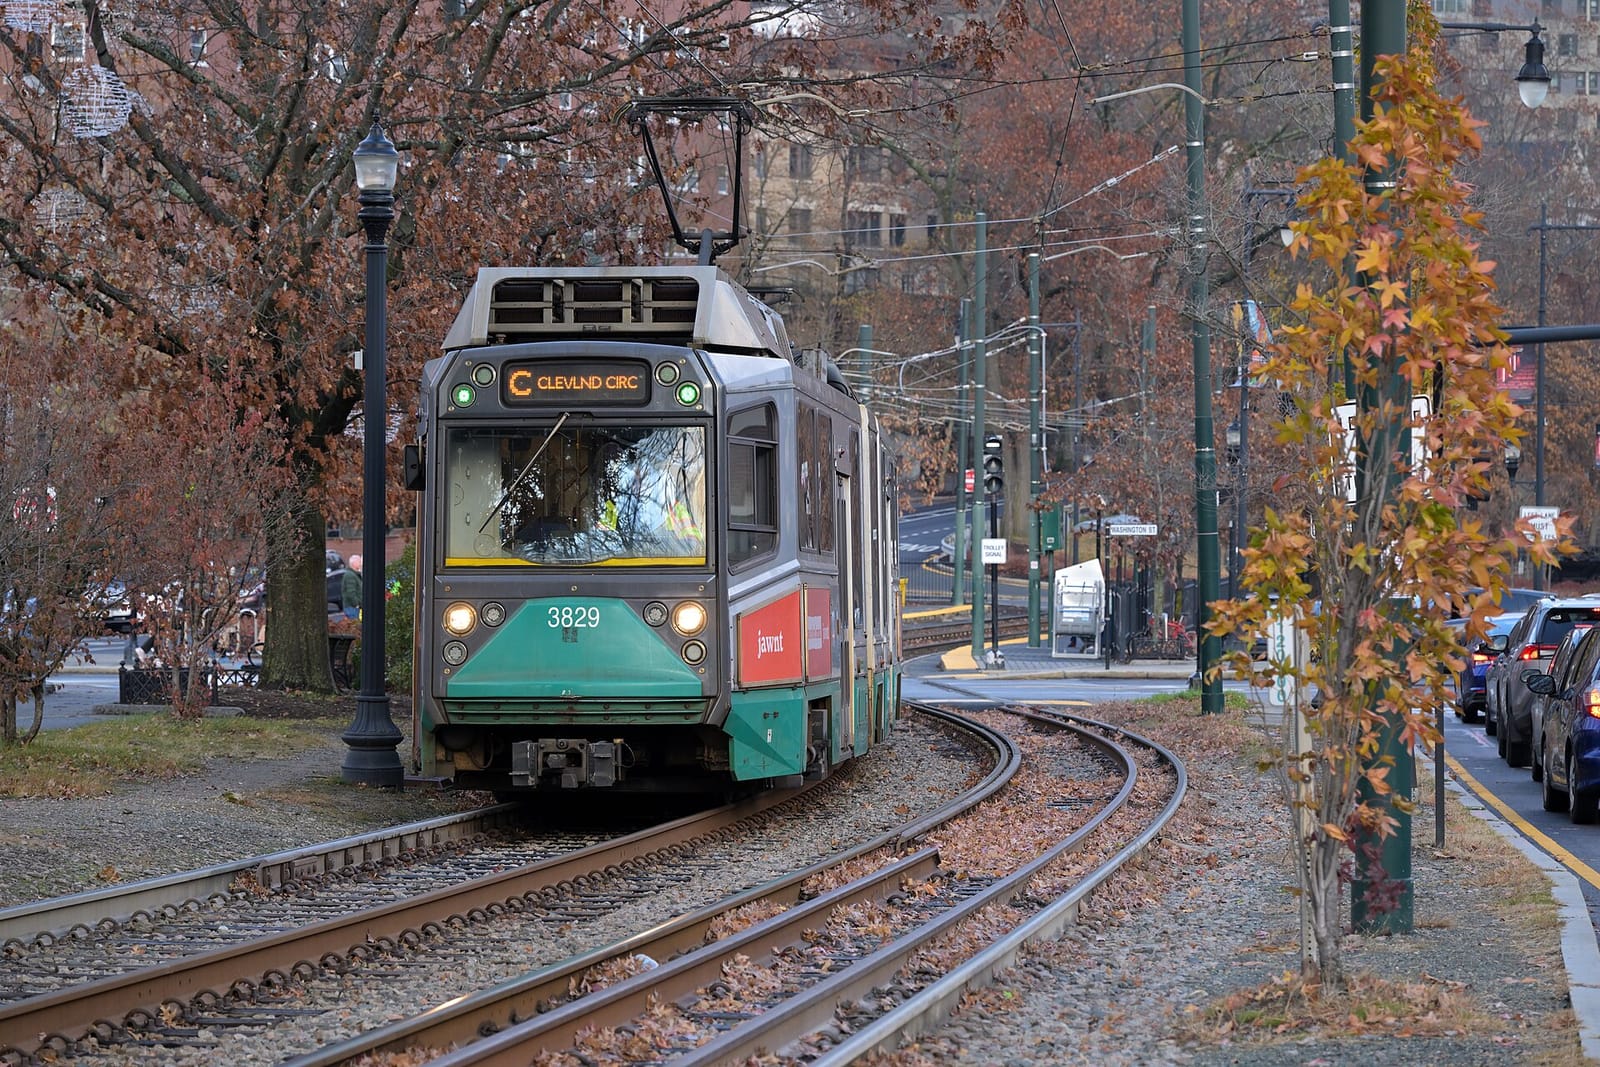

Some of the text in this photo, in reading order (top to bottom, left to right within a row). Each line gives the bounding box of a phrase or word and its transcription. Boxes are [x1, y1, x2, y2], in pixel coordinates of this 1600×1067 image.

[510, 370, 638, 396] C CLEVLND CIRC
[547, 606, 600, 628] 3829
[757, 629, 784, 660] jawnt
